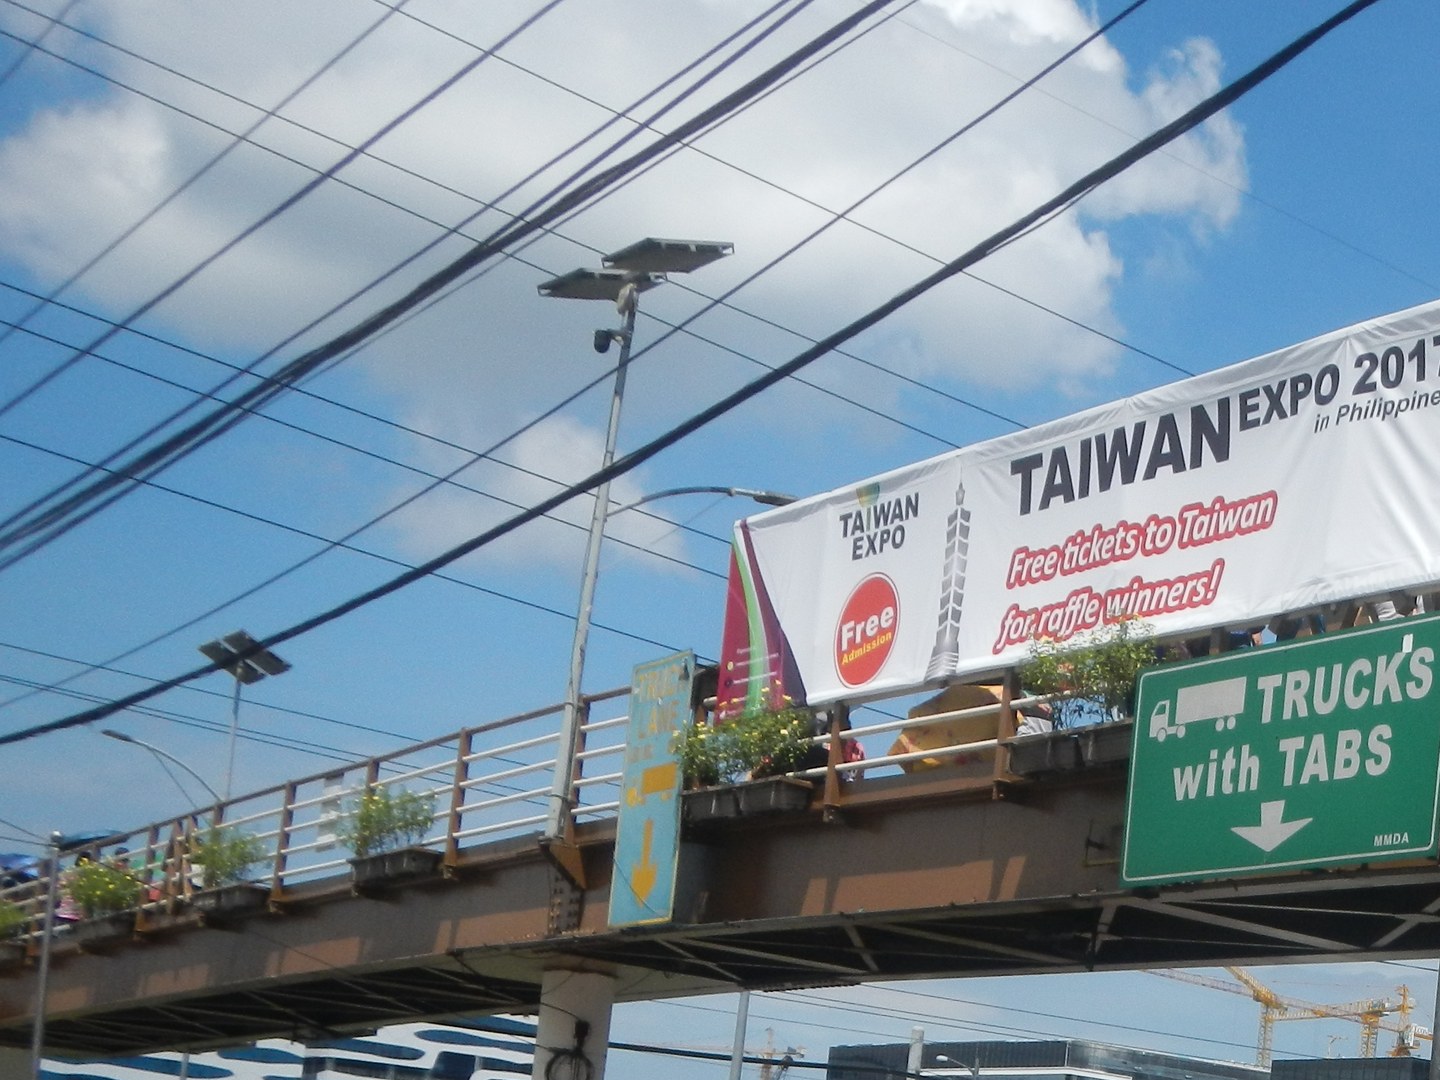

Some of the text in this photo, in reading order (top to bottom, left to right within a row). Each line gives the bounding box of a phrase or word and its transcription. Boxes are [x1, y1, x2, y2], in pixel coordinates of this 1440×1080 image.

[1010, 396, 1231, 516] TAIWAN
[1238, 362, 1341, 432] EXPO
[1313, 412, 1330, 434] in
[839, 492, 920, 539] TAIWAN
[1010, 493, 1276, 584] Free tickets to Taiwan
[852, 524, 906, 561] EXPO
[841, 606, 894, 652] Free
[998, 561, 1223, 652] for raffle winners!
[841, 631, 893, 666] Admission
[1173, 724, 1393, 802] with TABS
[1373, 831, 1410, 847] MMDA
